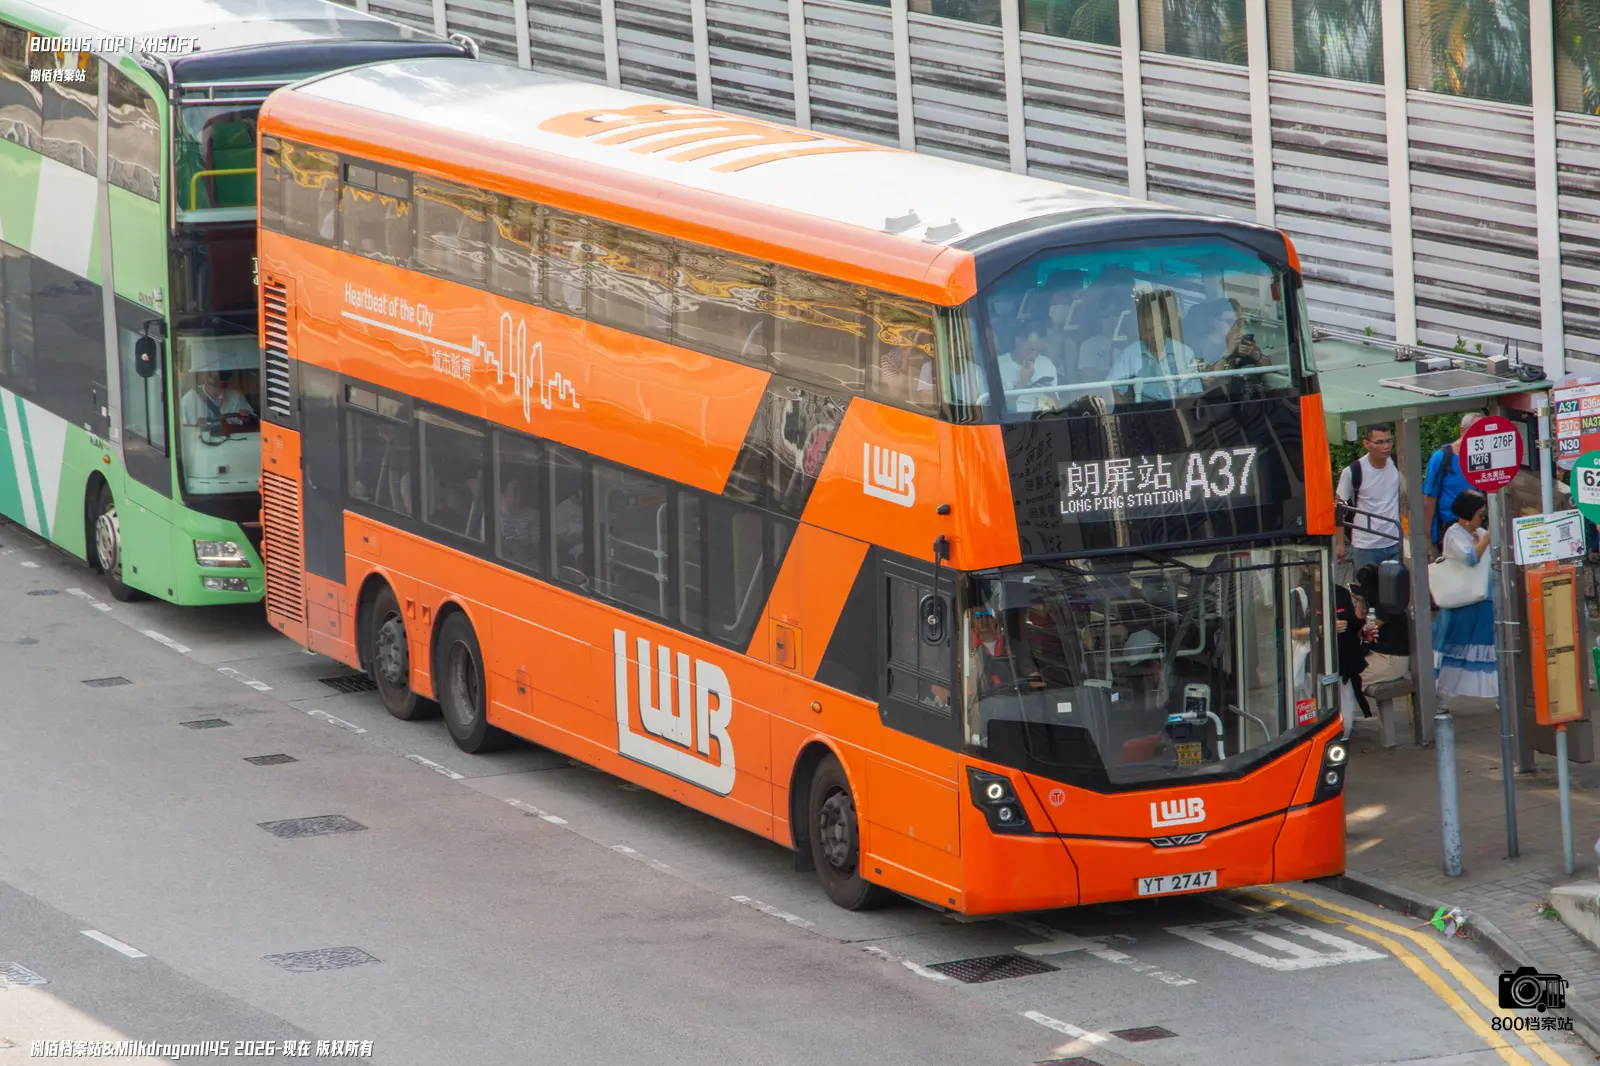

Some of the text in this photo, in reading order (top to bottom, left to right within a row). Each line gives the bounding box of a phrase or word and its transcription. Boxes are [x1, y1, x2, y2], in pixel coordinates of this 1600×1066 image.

[344, 282, 435, 334] Heartbeat of the City
[1558, 400, 1579, 413] A37
[1474, 434, 1514, 451] 53 276P
[1559, 438, 1580, 451] N30
[1184, 447, 1257, 500] A37
[1471, 453, 1489, 466] N276
[863, 442, 916, 508] LWB
[1067, 454, 1172, 497] 朗屏站
[1060, 499, 1092, 515] LONG
[1094, 494, 1125, 511] PING
[1127, 489, 1184, 508] STATION
[613, 627, 736, 797] LWB
[1150, 797, 1207, 828] LWB
[1143, 871, 1212, 893] YT 2747
